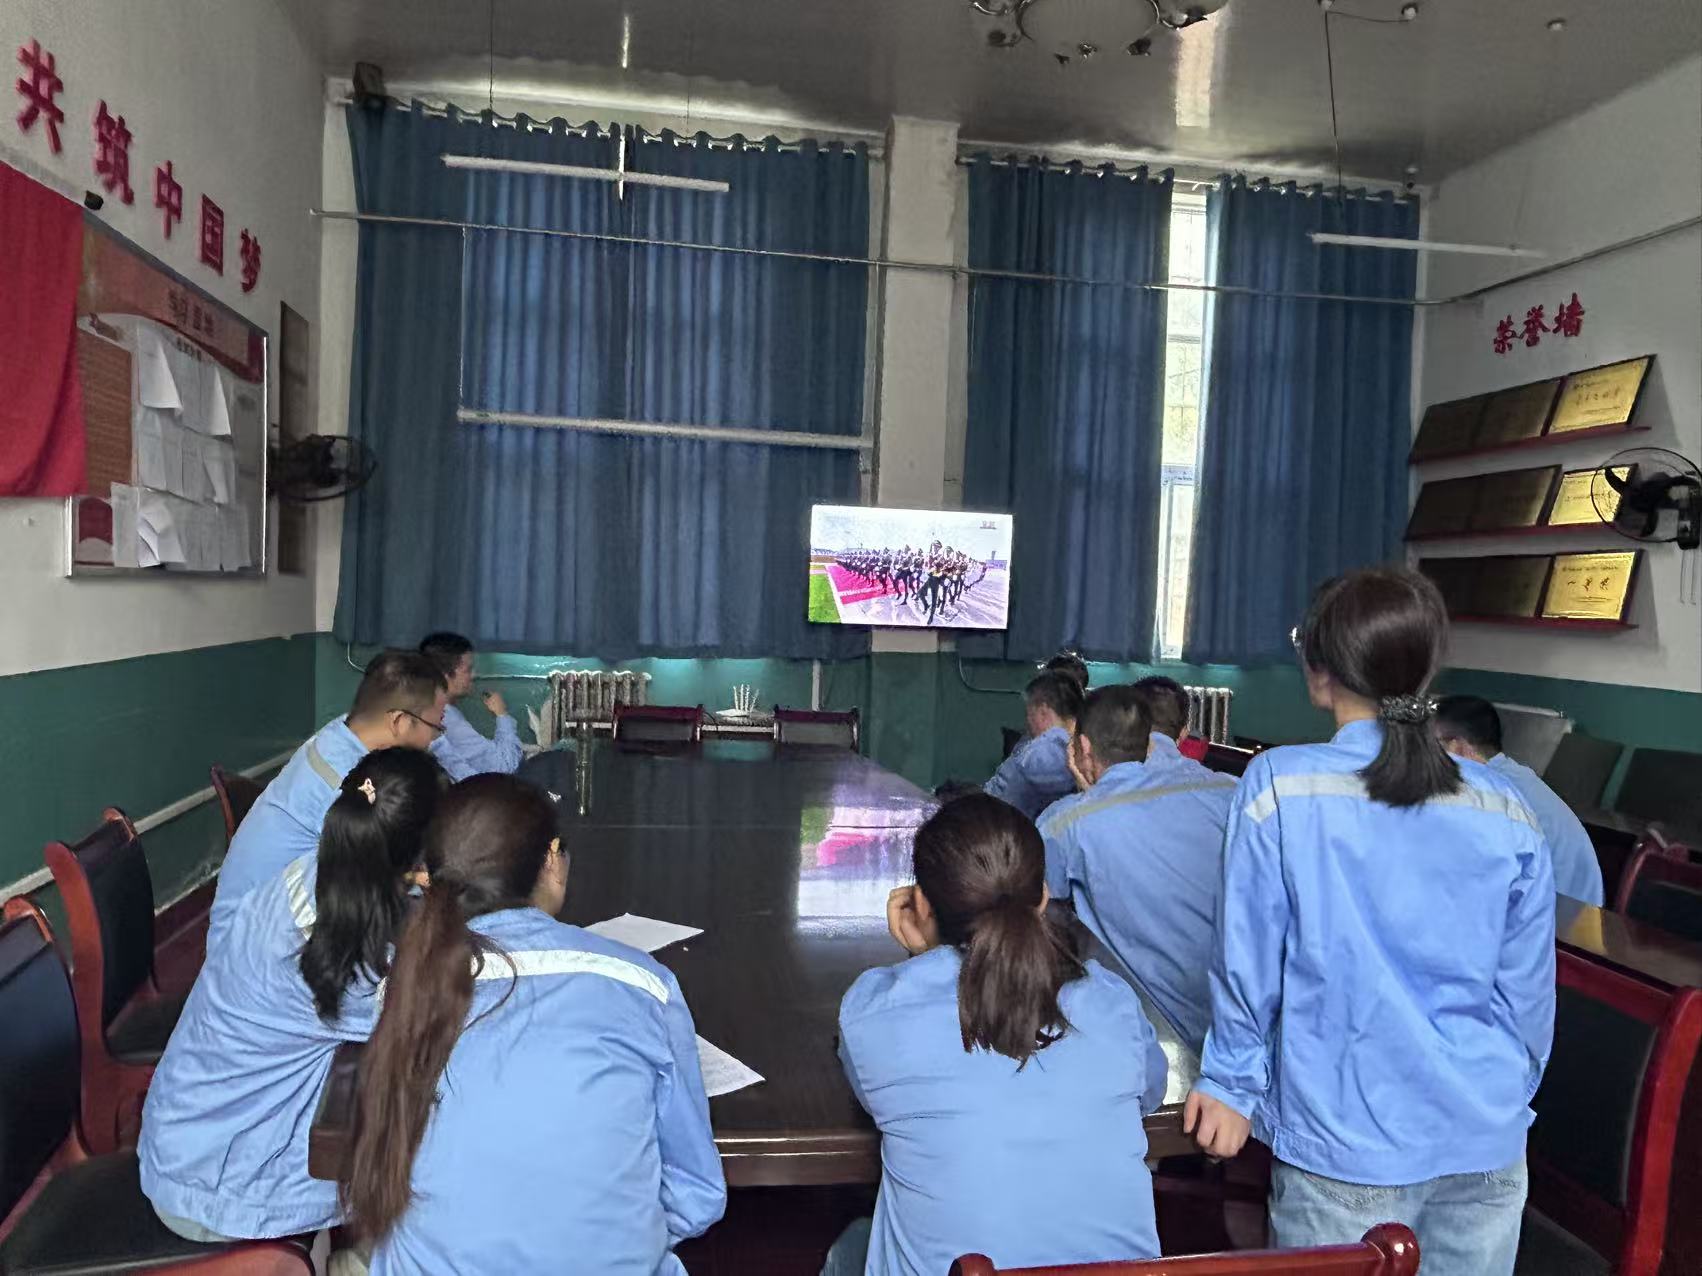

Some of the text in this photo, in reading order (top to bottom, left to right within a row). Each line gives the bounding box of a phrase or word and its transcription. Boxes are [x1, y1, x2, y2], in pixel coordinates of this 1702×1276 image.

[16, 38, 262, 293] 共筑中国梦
[1493, 292, 1585, 354] 荣誉墙
